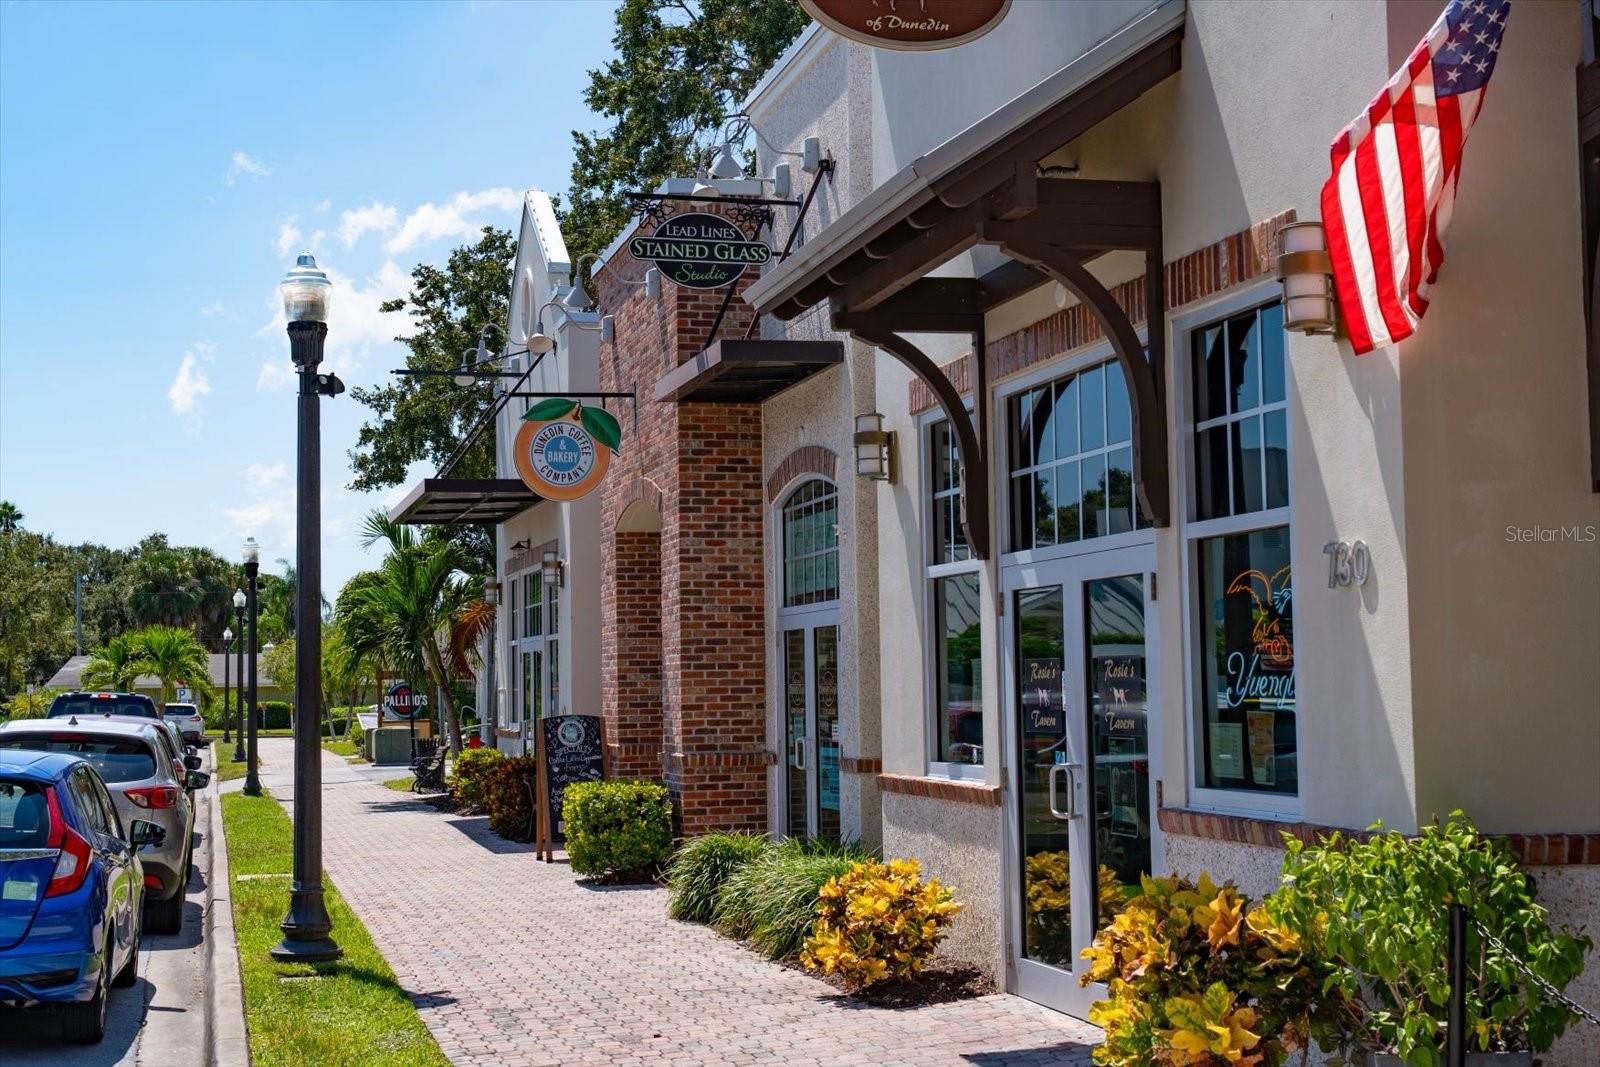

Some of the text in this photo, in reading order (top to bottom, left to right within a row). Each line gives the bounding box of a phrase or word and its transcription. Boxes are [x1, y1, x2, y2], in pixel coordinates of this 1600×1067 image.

[866, 15, 950, 31] of Dunedin
[666, 224, 736, 239] LEAD LINES
[633, 239, 767, 261] STAINED GLASS
[675, 263, 728, 282] Studio
[534, 425, 592, 456] DUNEDIN COFFEE
[560, 439, 567, 450] &
[547, 451, 578, 463] BAKERY
[540, 465, 585, 482] COMPANY
[1323, 540, 1370, 589] 730
[1030, 662, 1056, 682] Rosie's
[1104, 659, 1134, 682] Rosie's
[1031, 710, 1056, 728] Tavern
[1105, 712, 1135, 731] Tavern
